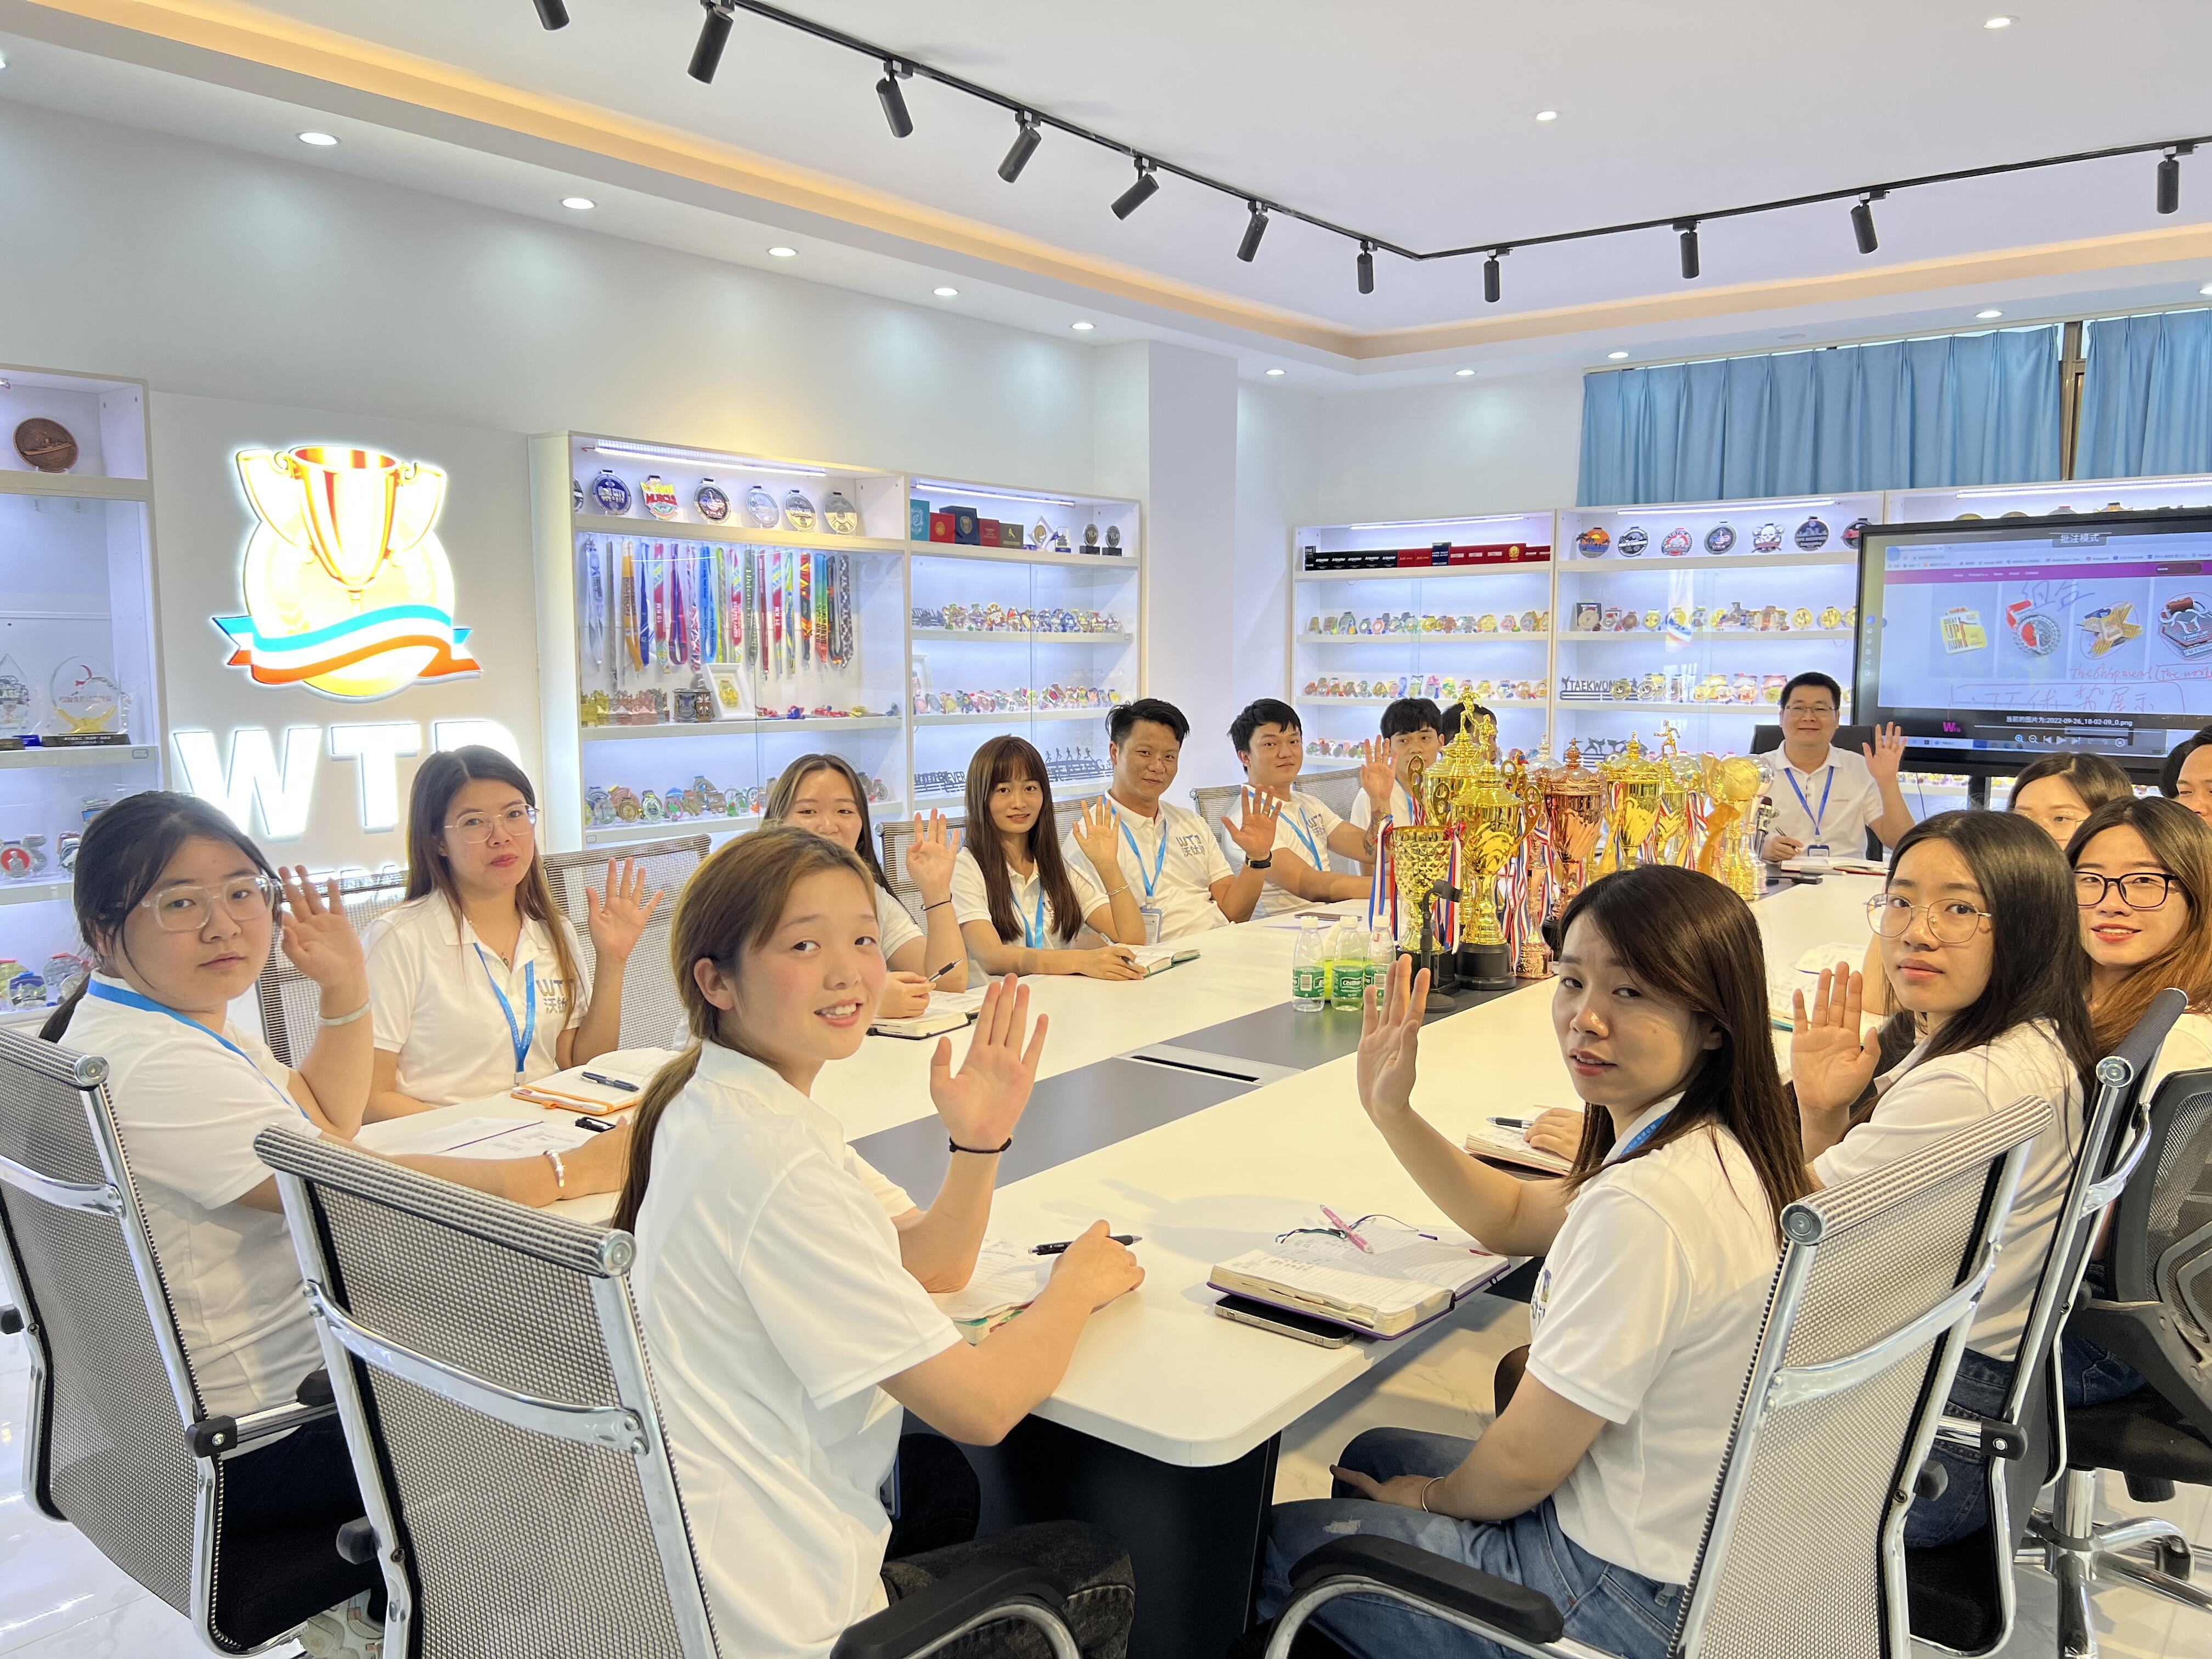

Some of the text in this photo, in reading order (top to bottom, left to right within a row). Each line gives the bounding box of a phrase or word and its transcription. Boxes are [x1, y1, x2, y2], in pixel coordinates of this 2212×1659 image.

[656, 603, 662, 623] 10 KM
[775, 606, 780, 617] KM
